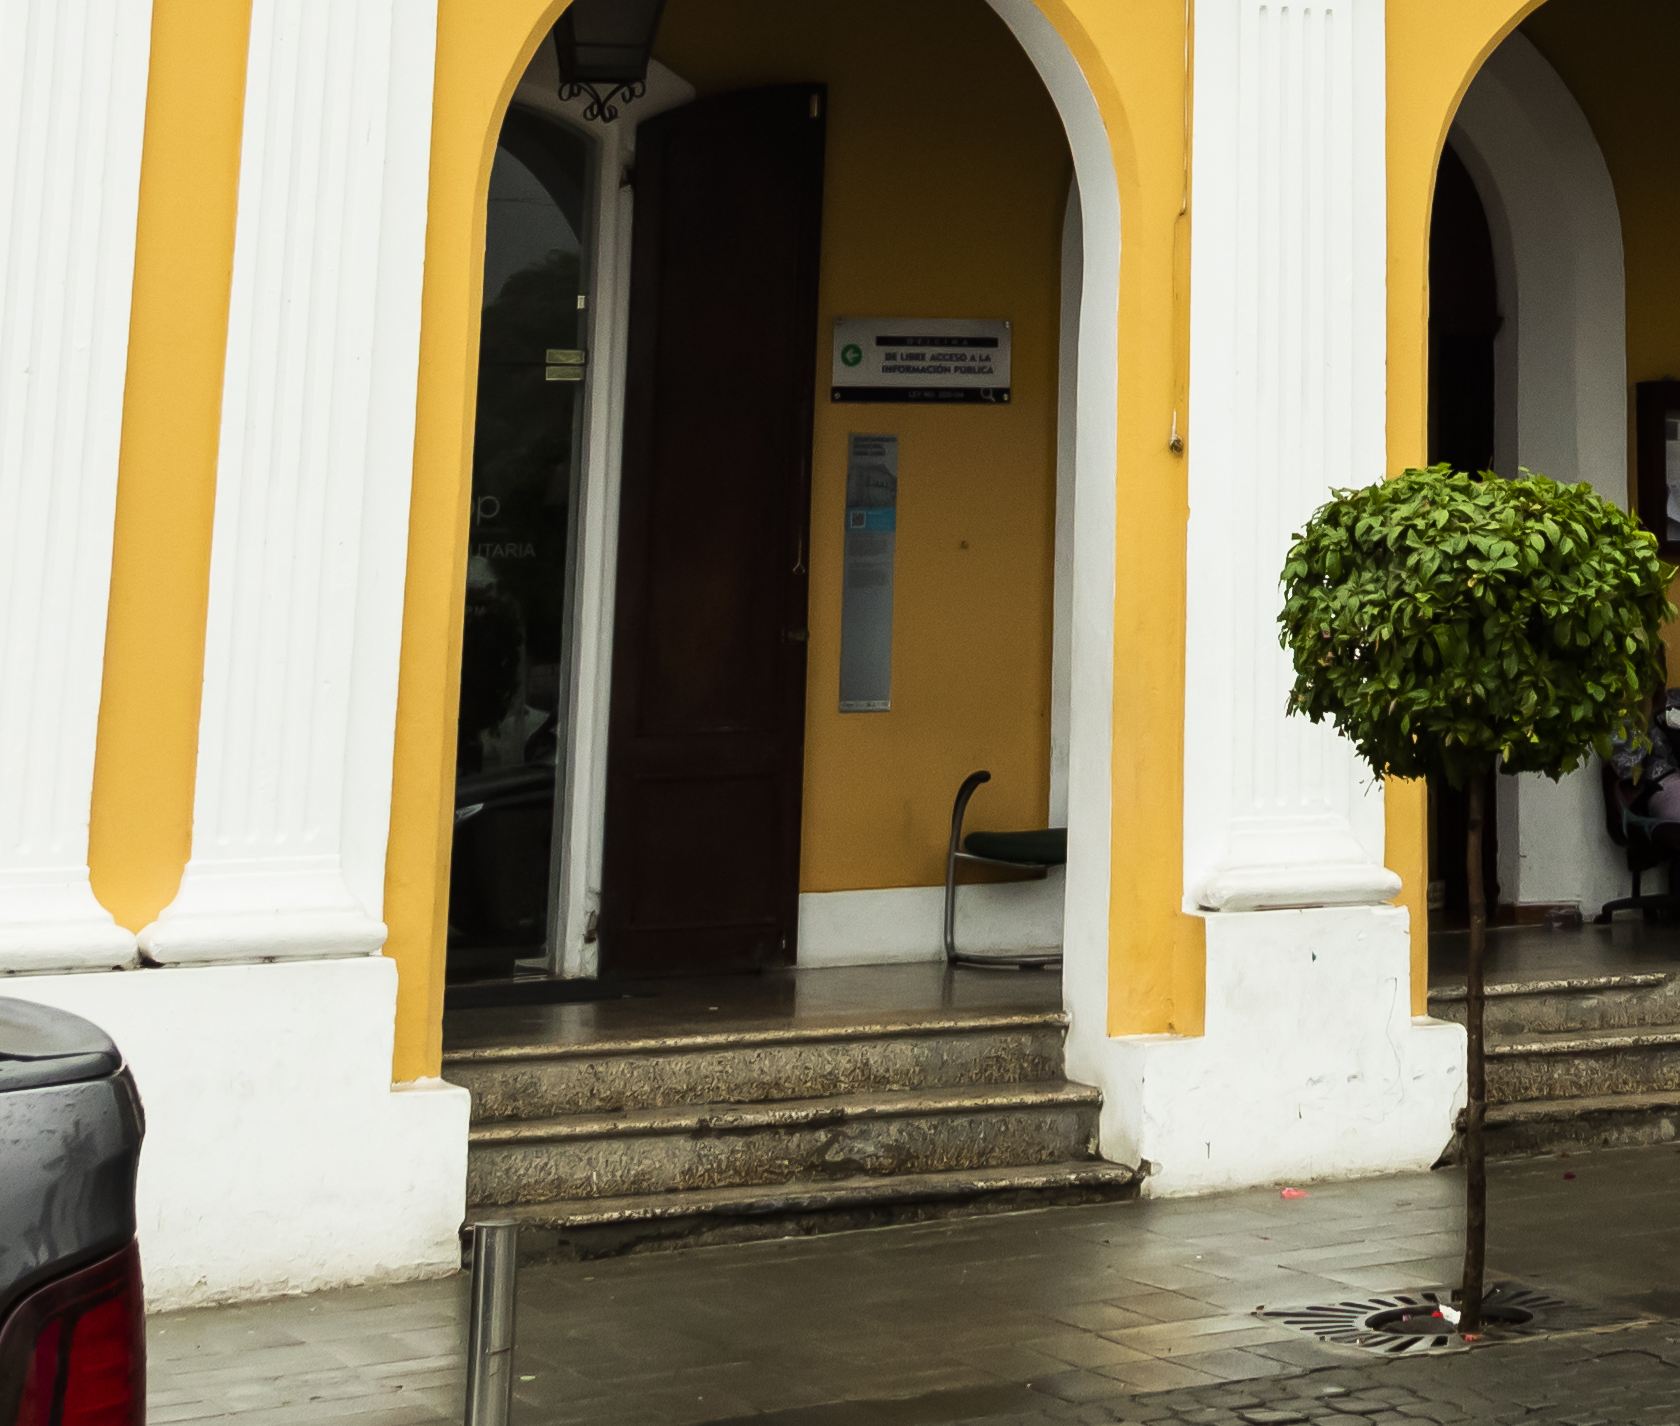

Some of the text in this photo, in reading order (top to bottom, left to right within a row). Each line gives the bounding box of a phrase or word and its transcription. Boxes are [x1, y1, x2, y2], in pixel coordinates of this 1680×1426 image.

[884, 352, 992, 363] DE LIBRE ACCESO A LA
